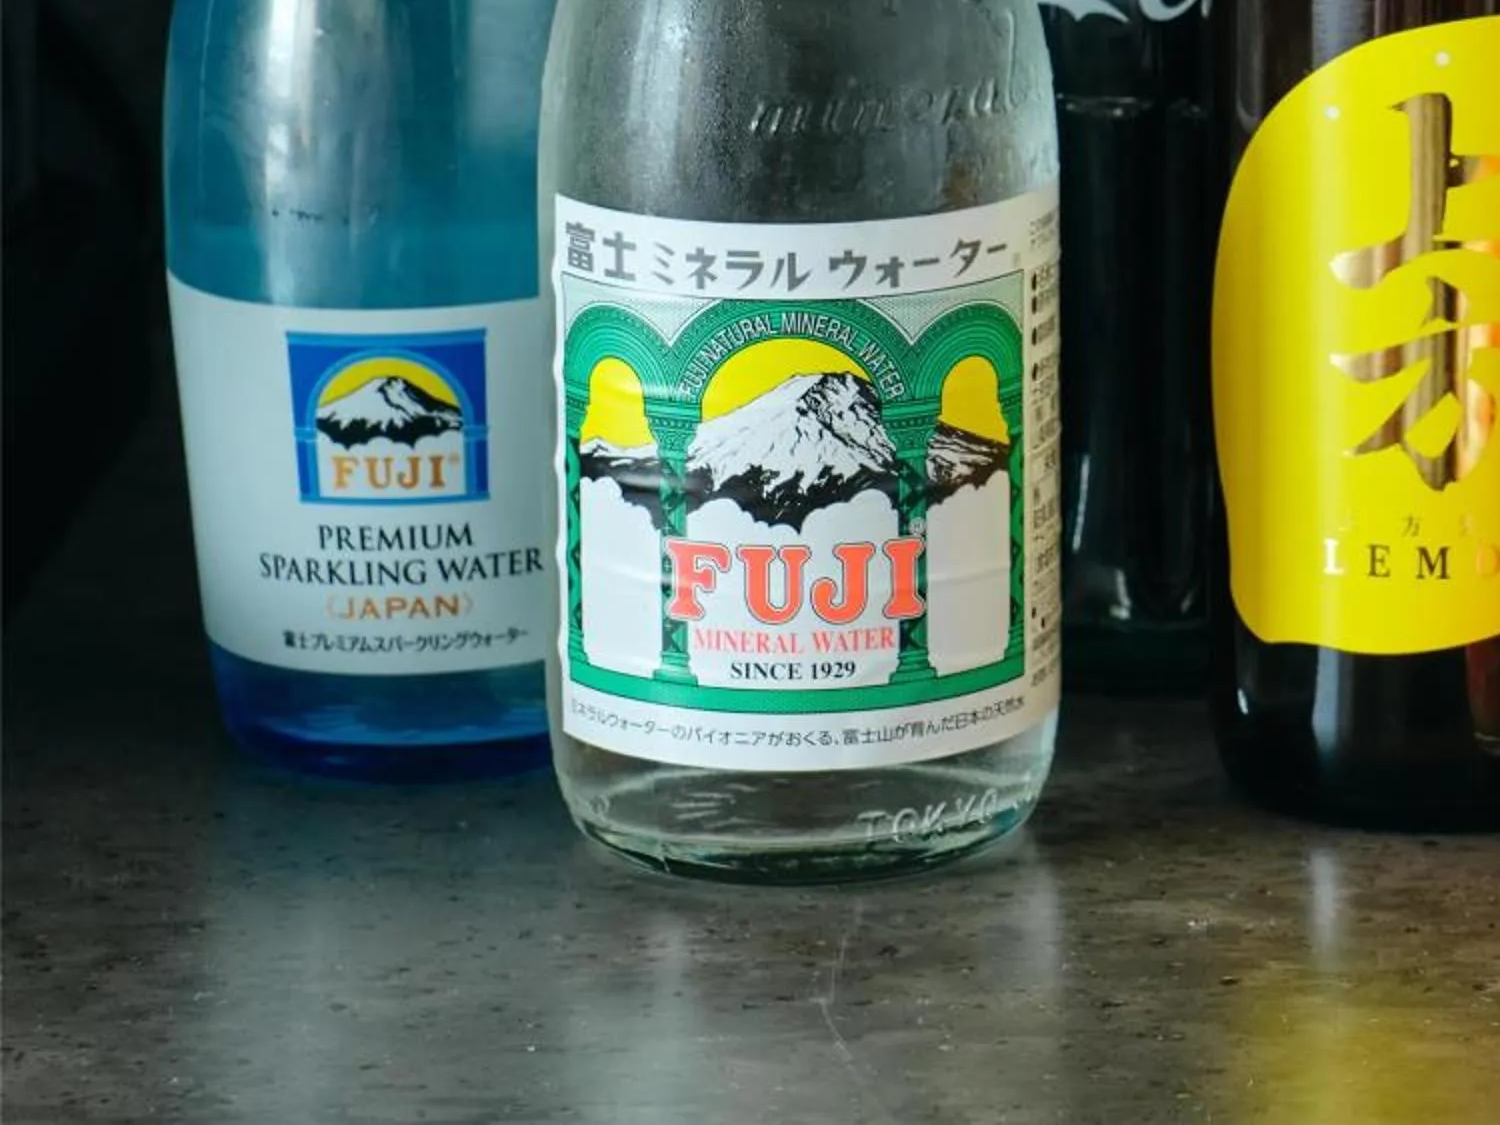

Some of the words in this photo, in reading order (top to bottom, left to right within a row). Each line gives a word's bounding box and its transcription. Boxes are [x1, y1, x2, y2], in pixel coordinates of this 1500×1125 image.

[699, 314, 777, 365] NATURAL
[781, 312, 857, 352] MINERAL
[859, 338, 905, 401] WATER
[331, 454, 446, 491] FUJI
[317, 522, 474, 552] PREMIUM
[258, 552, 427, 586] SPARKLING
[436, 547, 544, 582] WATER
[664, 537, 927, 626] FUJI
[692, 627, 805, 655] MINERAL
[811, 626, 896, 652] WATER
[730, 662, 803, 682] SINCE
[809, 661, 857, 682] 1929
